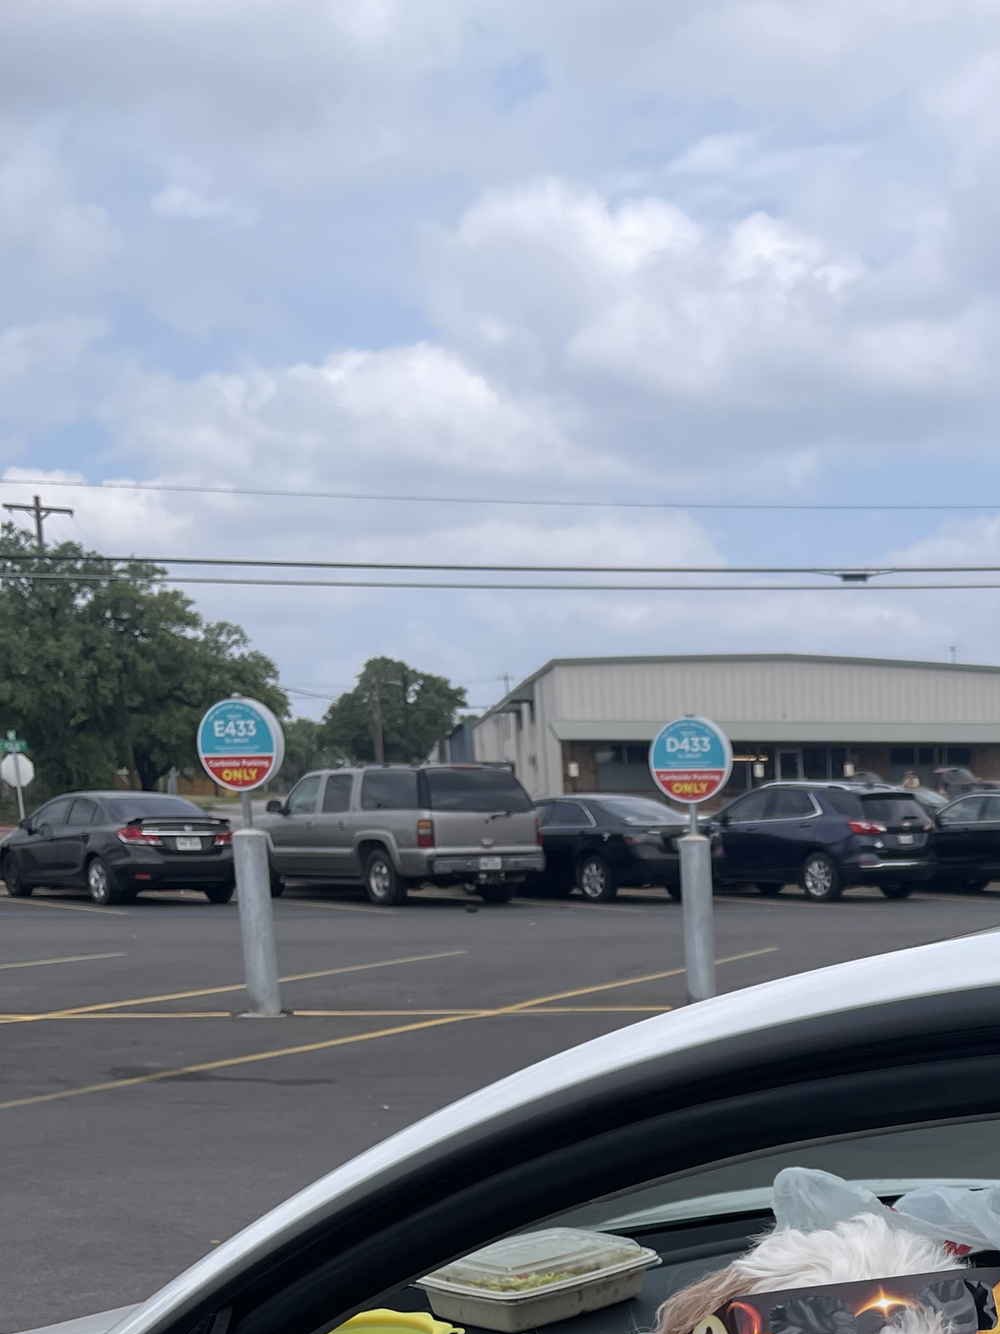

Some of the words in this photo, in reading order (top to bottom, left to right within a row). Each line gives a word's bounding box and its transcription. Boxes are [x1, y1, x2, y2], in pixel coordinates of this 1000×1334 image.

[213, 720, 257, 737] E433
[666, 736, 711, 753] D433
[222, 768, 257, 781] ONLY
[672, 782, 708, 794] ONLY
